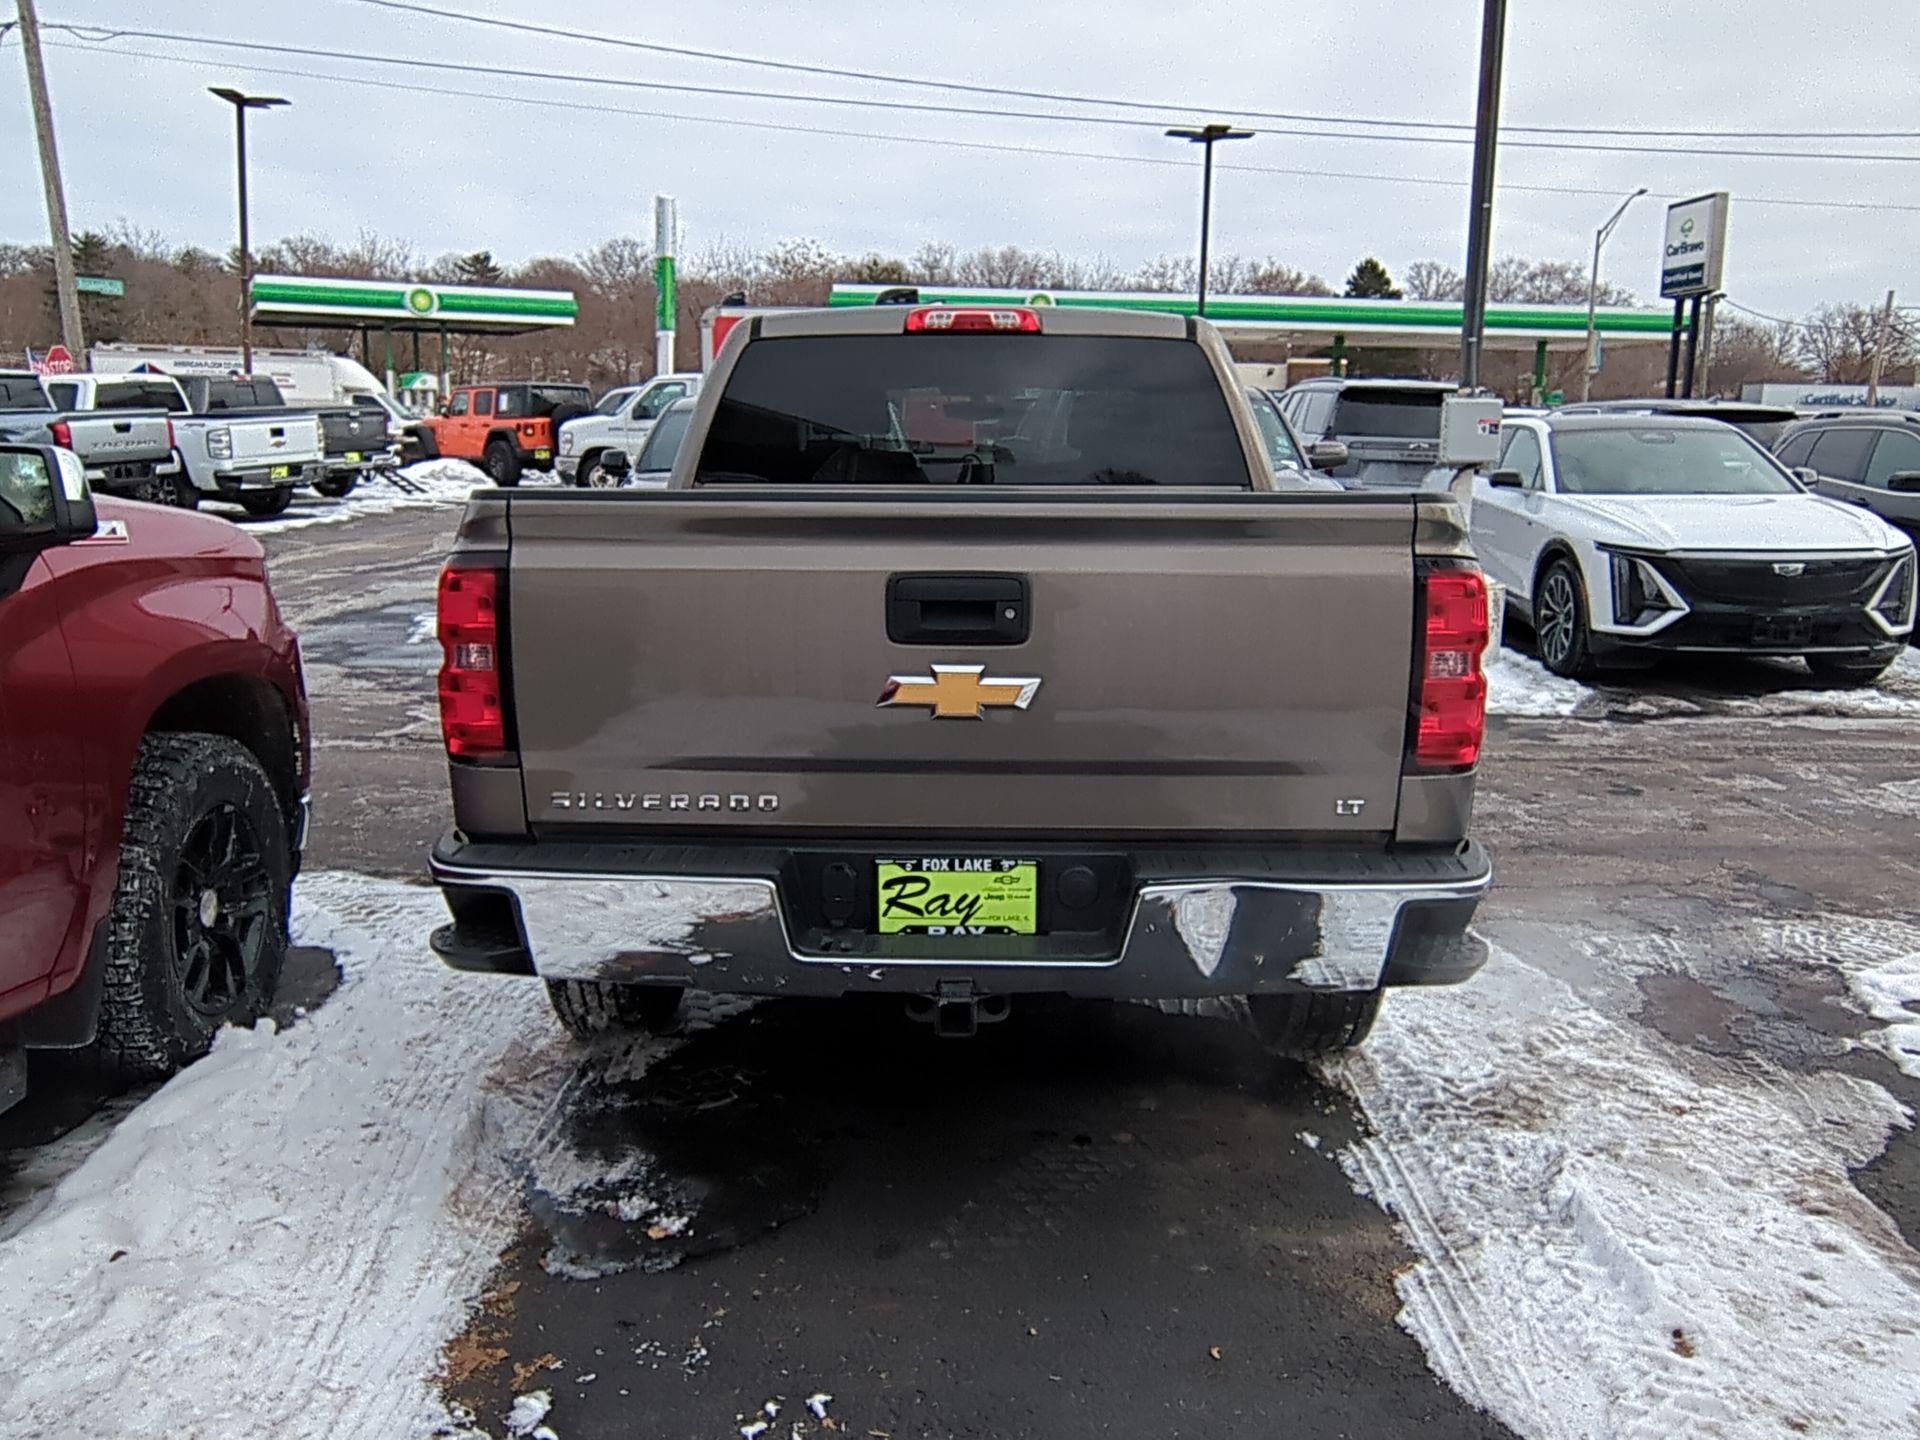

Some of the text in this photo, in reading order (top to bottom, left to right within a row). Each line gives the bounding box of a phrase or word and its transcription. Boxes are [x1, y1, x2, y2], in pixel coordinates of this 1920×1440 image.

[1666, 241, 1704, 257] CarBravo
[1804, 394, 1854, 405] Certified
[91, 439, 158, 449] TACOMA
[551, 792, 779, 811] SILVERADO
[1336, 799, 1365, 815] LT
[922, 859, 949, 871] FOX
[954, 859, 992, 871] LAKE
[882, 875, 983, 925] Ray
